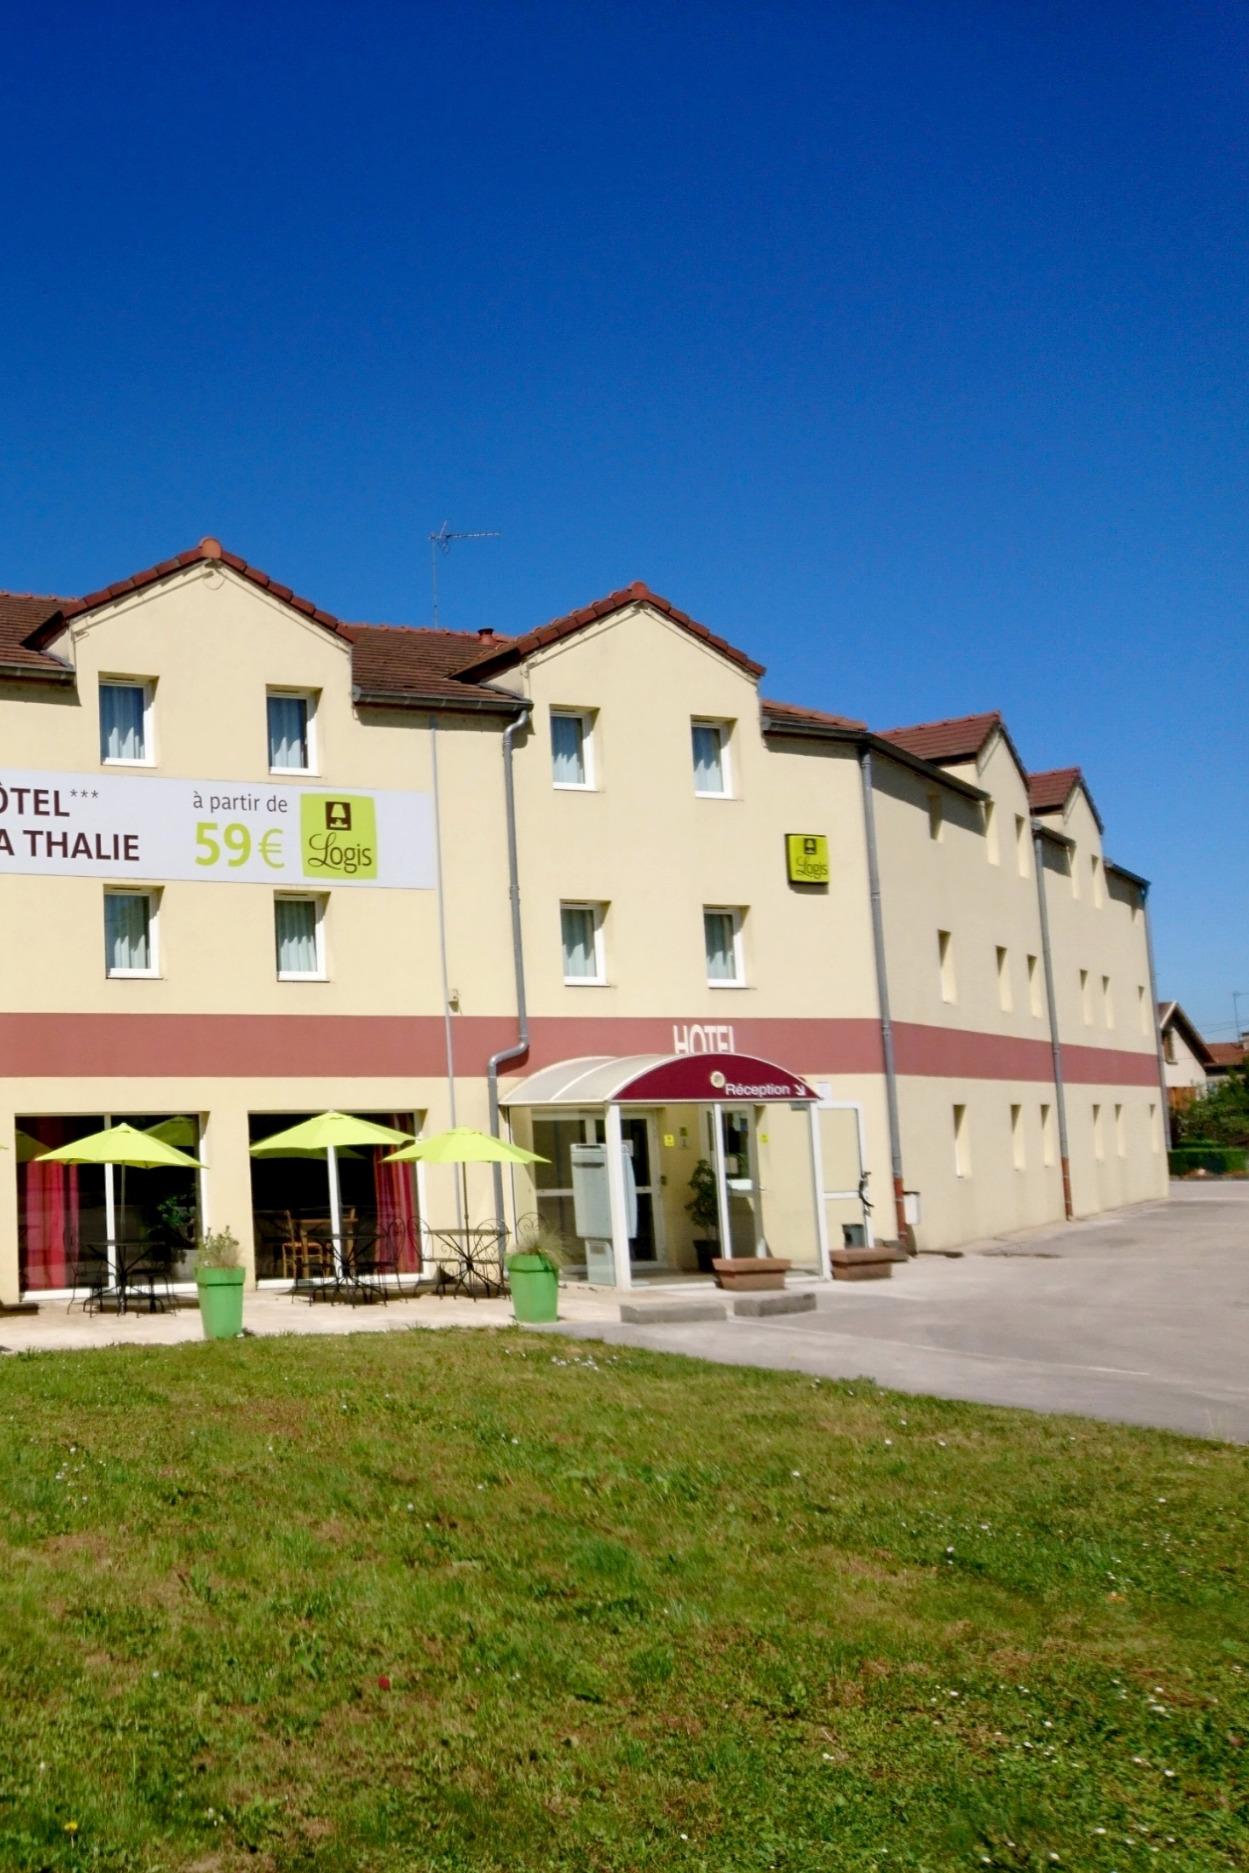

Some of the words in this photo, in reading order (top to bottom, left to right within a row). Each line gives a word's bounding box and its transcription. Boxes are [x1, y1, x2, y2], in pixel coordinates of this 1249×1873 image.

[192, 791, 204, 809] à
[210, 793, 260, 813] partir
[266, 795, 288, 813] de
[23, 829, 140, 861] THALIE
[307, 832, 372, 874] Logis
[795, 856, 828, 879] Logis
[725, 1083, 790, 1097] Réception
